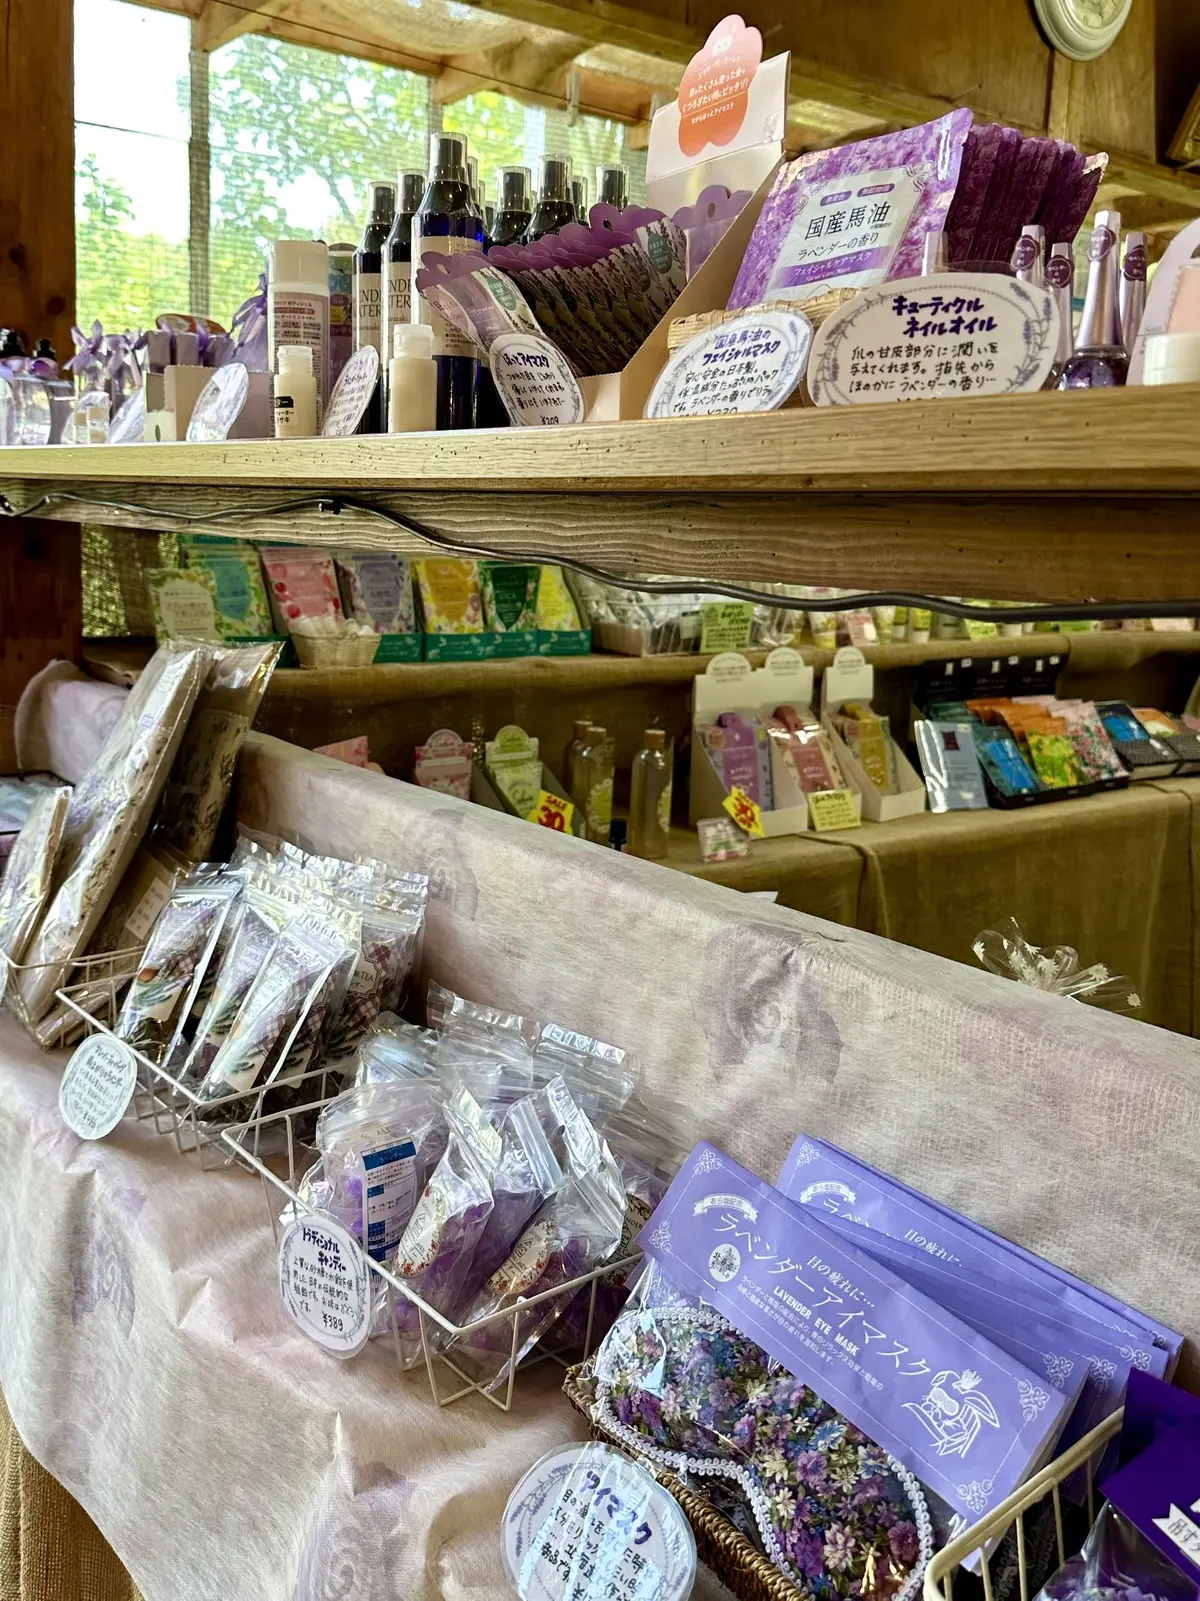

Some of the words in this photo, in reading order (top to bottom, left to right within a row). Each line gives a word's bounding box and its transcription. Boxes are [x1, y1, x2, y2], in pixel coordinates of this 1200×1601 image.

[804, 201, 891, 240] 国産馬油
[798, 232, 879, 261] ラベンダーの香り
[892, 295, 985, 316] キューティクル
[715, 328, 771, 349] 国産馬油の
[903, 316, 997, 338] ネイルオイル
[502, 352, 550, 368] ほっとアイマスク
[702, 340, 781, 366] フェイシャルマスク
[545, 795, 568, 811] SALE
[538, 806, 565, 833] 30
[302, 1227, 340, 1254] トラディショナル
[318, 1251, 347, 1272] キャンディー
[713, 1212, 931, 1376] ラベンダーアイマスク
[322, 1311, 344, 1332] ¥389
[773, 1285, 812, 1321] LAVENDER
[814, 1317, 833, 1335] EYE
[834, 1333, 861, 1357] MASK
[580, 1470, 653, 1545] アイマスク
